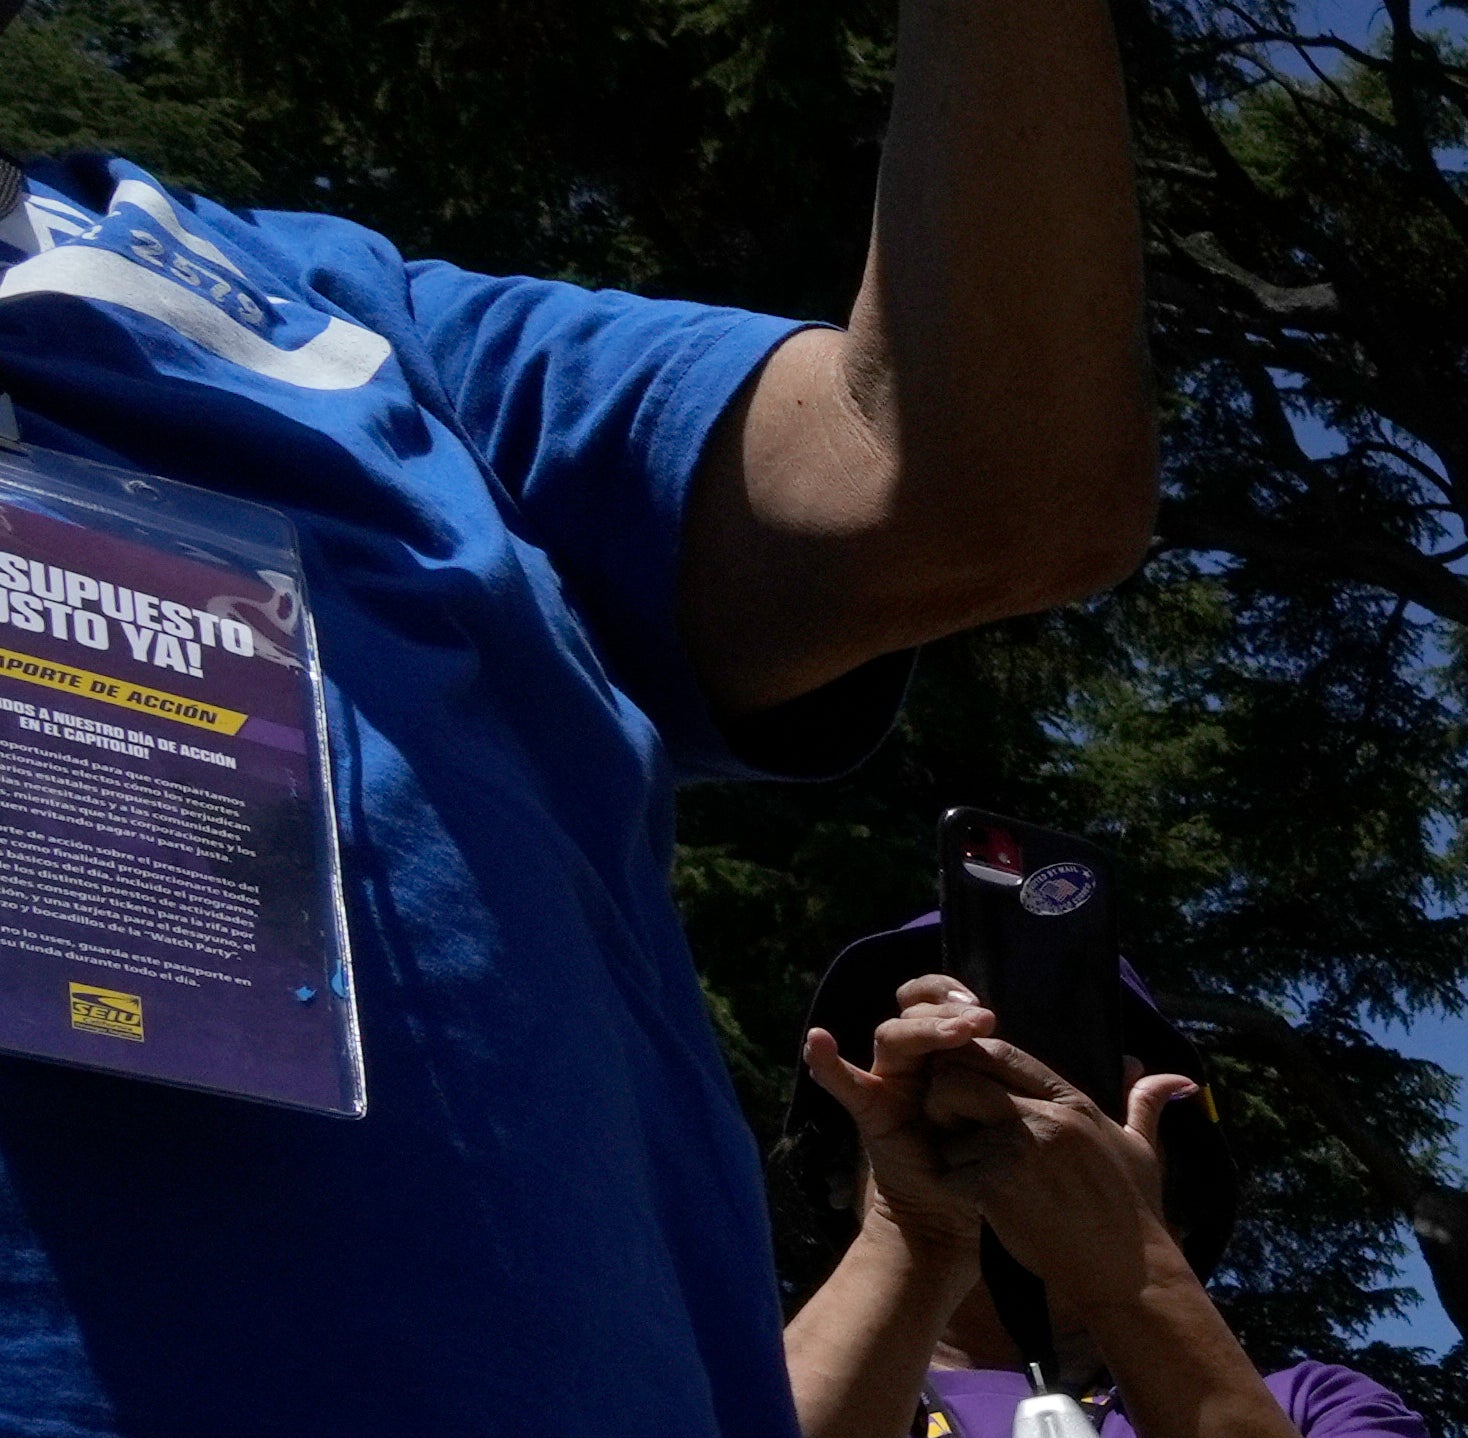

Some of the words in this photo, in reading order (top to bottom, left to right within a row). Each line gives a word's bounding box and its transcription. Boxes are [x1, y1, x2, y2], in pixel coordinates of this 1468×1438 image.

[0, 551, 254, 659] SUPUESTO
[0, 587, 109, 652] STO
[119, 622, 203, 679] YA!
[0, 654, 82, 690] PORTE
[89, 678, 120, 700] DE
[126, 687, 218, 726] ACCIÓN
[19, 715, 40, 733] EN
[43, 721, 61, 737] EL
[62, 726, 149, 761] CAPITOLIO!
[37, 706, 50, 721] A
[52, 709, 124, 741] NUESTRO
[127, 729, 154, 748] DÍA
[156, 737, 177, 754] DE
[180, 743, 236, 770] ACCIÓN
[0, 741, 88, 767] oportunidad
[91, 762, 122, 775] para
[125, 770, 151, 783] que
[153, 780, 245, 806] compartamos
[35, 773, 97, 793] estatales
[100, 789, 177, 811] propuestos
[180, 809, 251, 831] perjudican
[71, 769, 120, 787] electos
[122, 782, 161, 797] cómo
[164, 790, 182, 803] los
[185, 799, 240, 817] recortes
[13, 791, 76, 812] mientras
[81, 807, 105, 818] que
[108, 813, 127, 824] las
[129, 821, 224, 848] corporaciones
[237, 845, 256, 858] los
[23, 783, 106, 806] necesitadas
[130, 805, 149, 817] las
[151, 814, 241, 842] comunidades
[30, 808, 93, 829] evitando
[95, 822, 136, 839] pagar
[157, 840, 193, 852] parte
[6, 849, 59, 869] básicos
[61, 862, 84, 875] del
[115, 874, 170, 895] incluido
[10, 839, 50, 855] como
[52, 848, 115, 870] finalidad
[117, 865, 220, 894] proporcionarte
[222, 889, 260, 906] todos
[13, 863, 35, 876] los
[37, 869, 99, 890] distintos
[101, 887, 156, 903] puestos
[178, 905, 254, 928] actividades
[95, 848, 134, 861] sobre
[152, 863, 235, 886] presupuesto
[237, 881, 259, 894] del
[32, 905, 105, 929] bocadillos
[107, 922, 125, 934] de
[36, 884, 106, 904] conseguir
[108, 897, 155, 916] tickets
[157, 910, 188, 923] para
[231, 928, 254, 938] por
[42, 896, 70, 909] una
[72, 902, 120, 920] tarjeta
[122, 914, 154, 928] para
[0, 925, 19, 935] no
[78, 943, 128, 959] guarda
[131, 956, 160, 966] este
[162, 964, 231, 982] pasaporte
[233, 976, 251, 987] en
[0, 937, 16, 948] su
[19, 940, 62, 957] funda
[64, 950, 121, 970] durante
[123, 963, 157, 978] todo
[159, 972, 172, 981] el
[72, 1003, 141, 1025] SEIU
